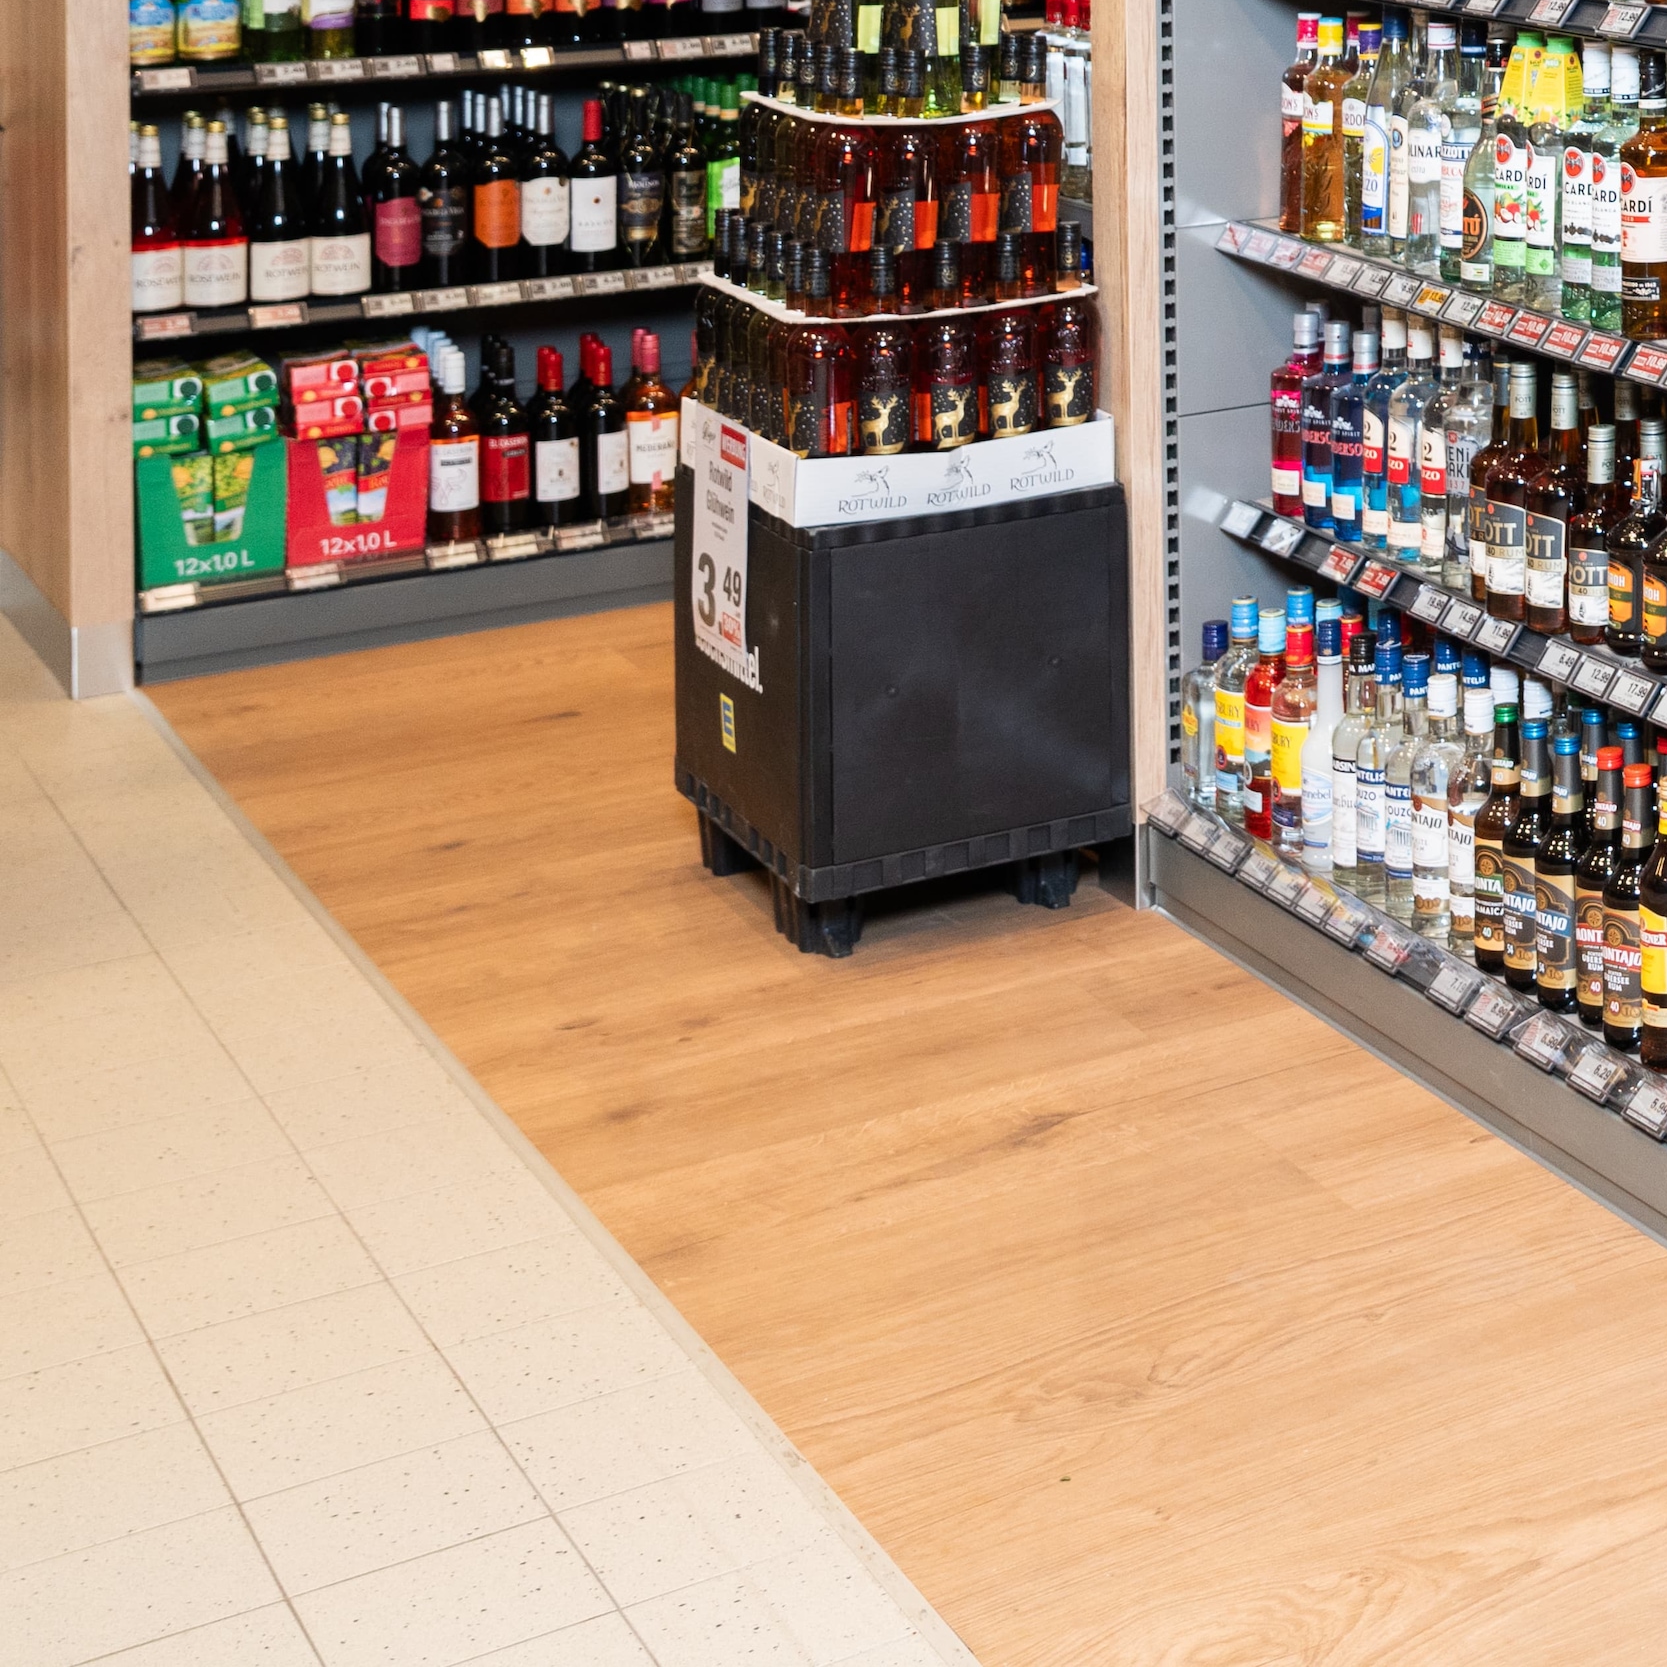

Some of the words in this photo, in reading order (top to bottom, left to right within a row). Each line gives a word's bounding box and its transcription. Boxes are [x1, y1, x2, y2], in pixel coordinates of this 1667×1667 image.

[709, 460, 733, 492] Rotwild
[1010, 468, 1074, 492] ROTWILD
[838, 495, 907, 515] ROTWILD
[927, 482, 991, 506] ROTWILD
[705, 493, 735, 525] Glühwein
[1627, 682, 1648, 697] 17.99
